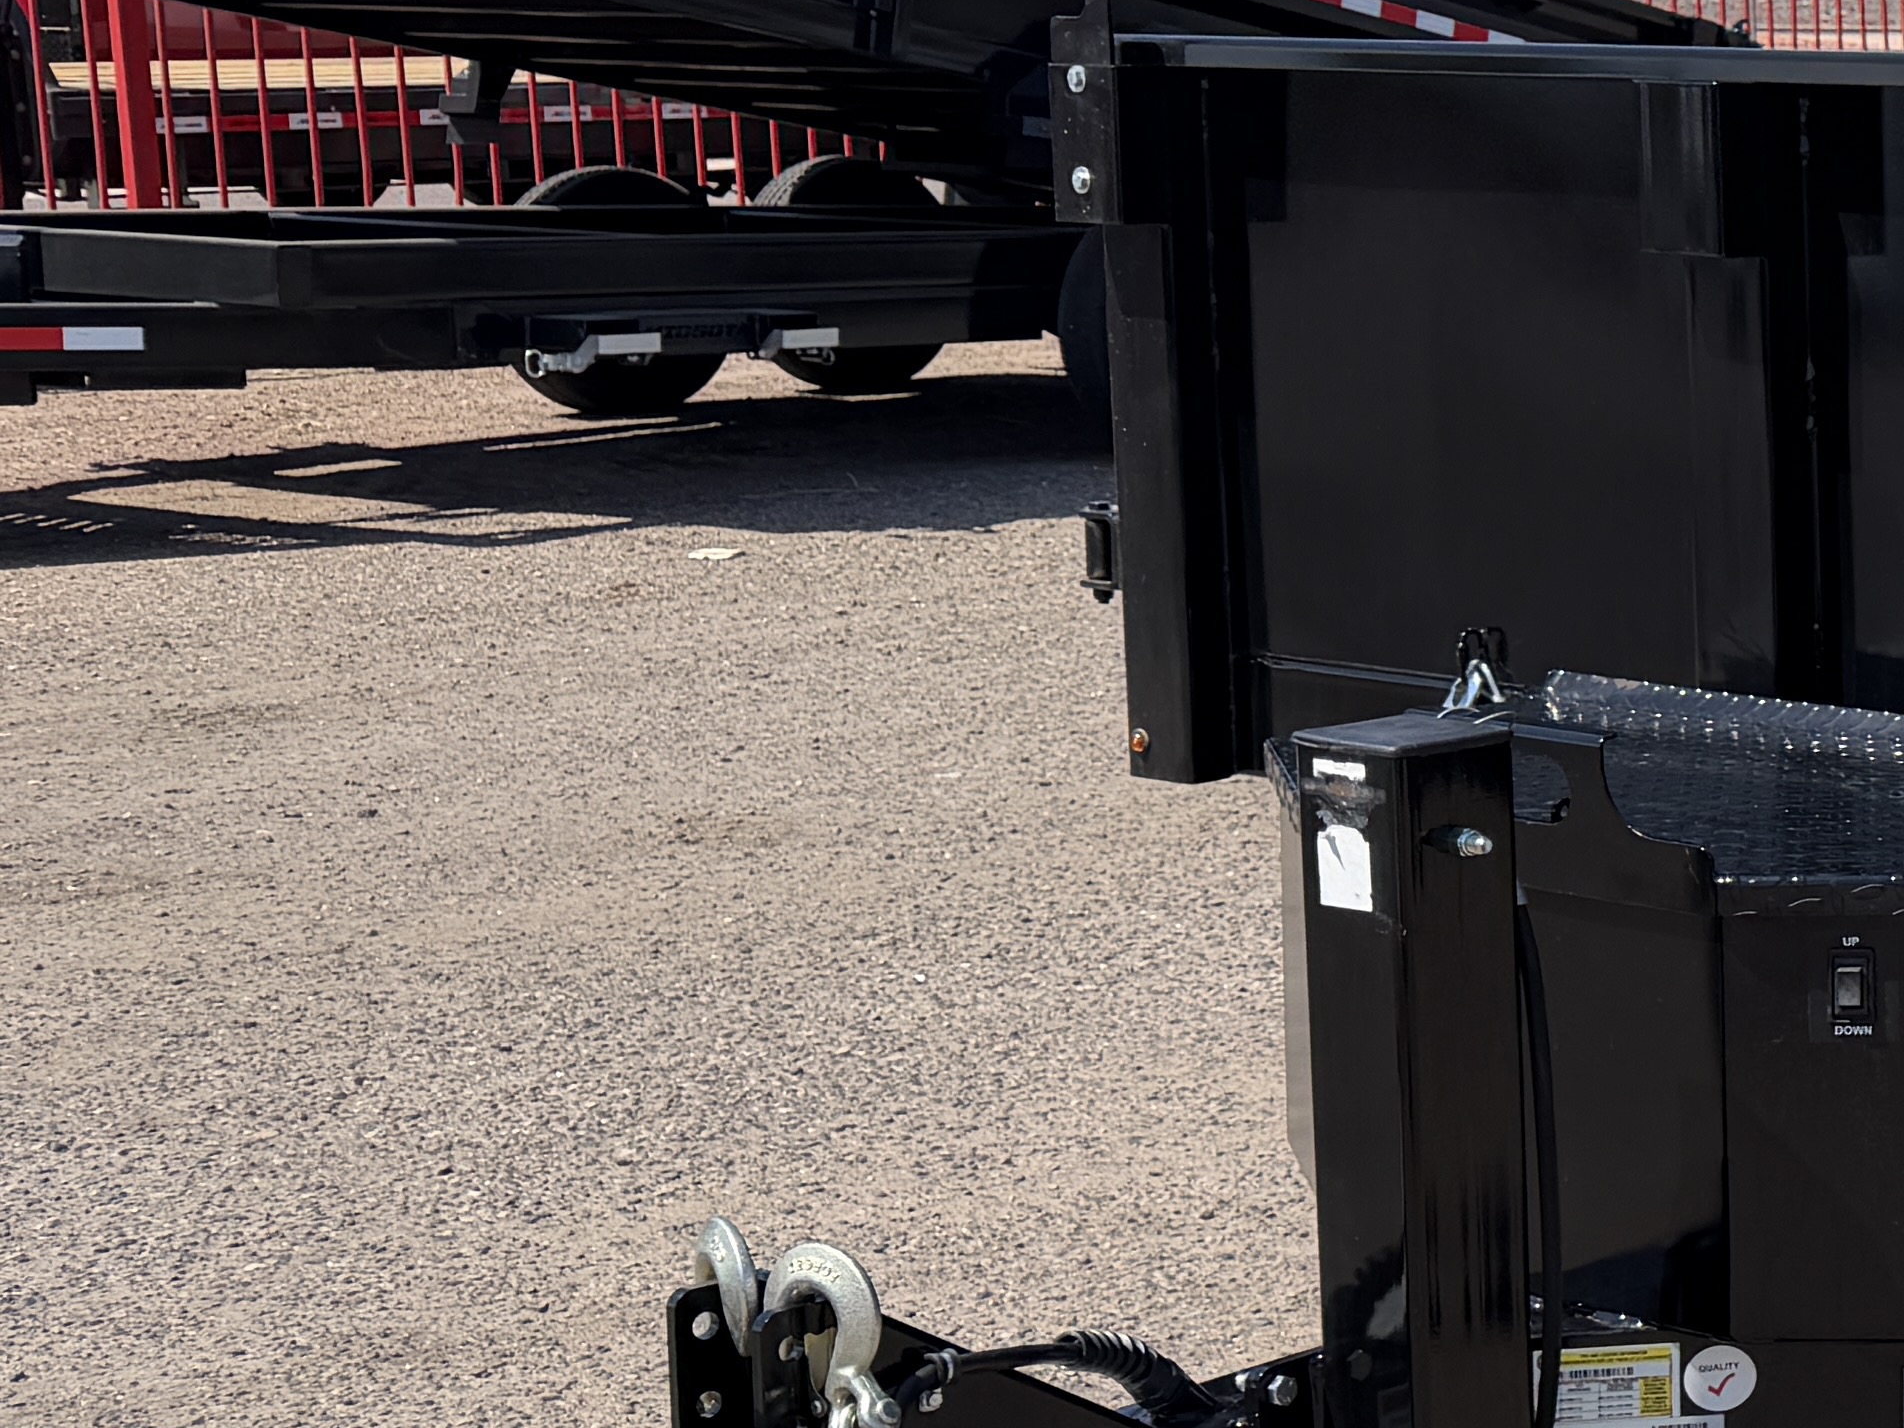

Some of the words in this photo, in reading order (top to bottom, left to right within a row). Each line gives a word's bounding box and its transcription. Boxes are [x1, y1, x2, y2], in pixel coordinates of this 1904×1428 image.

[1842, 936, 1860, 947] UP
[1834, 1025, 1872, 1036] DOWN
[1698, 1361, 1740, 1373] QUALITY
